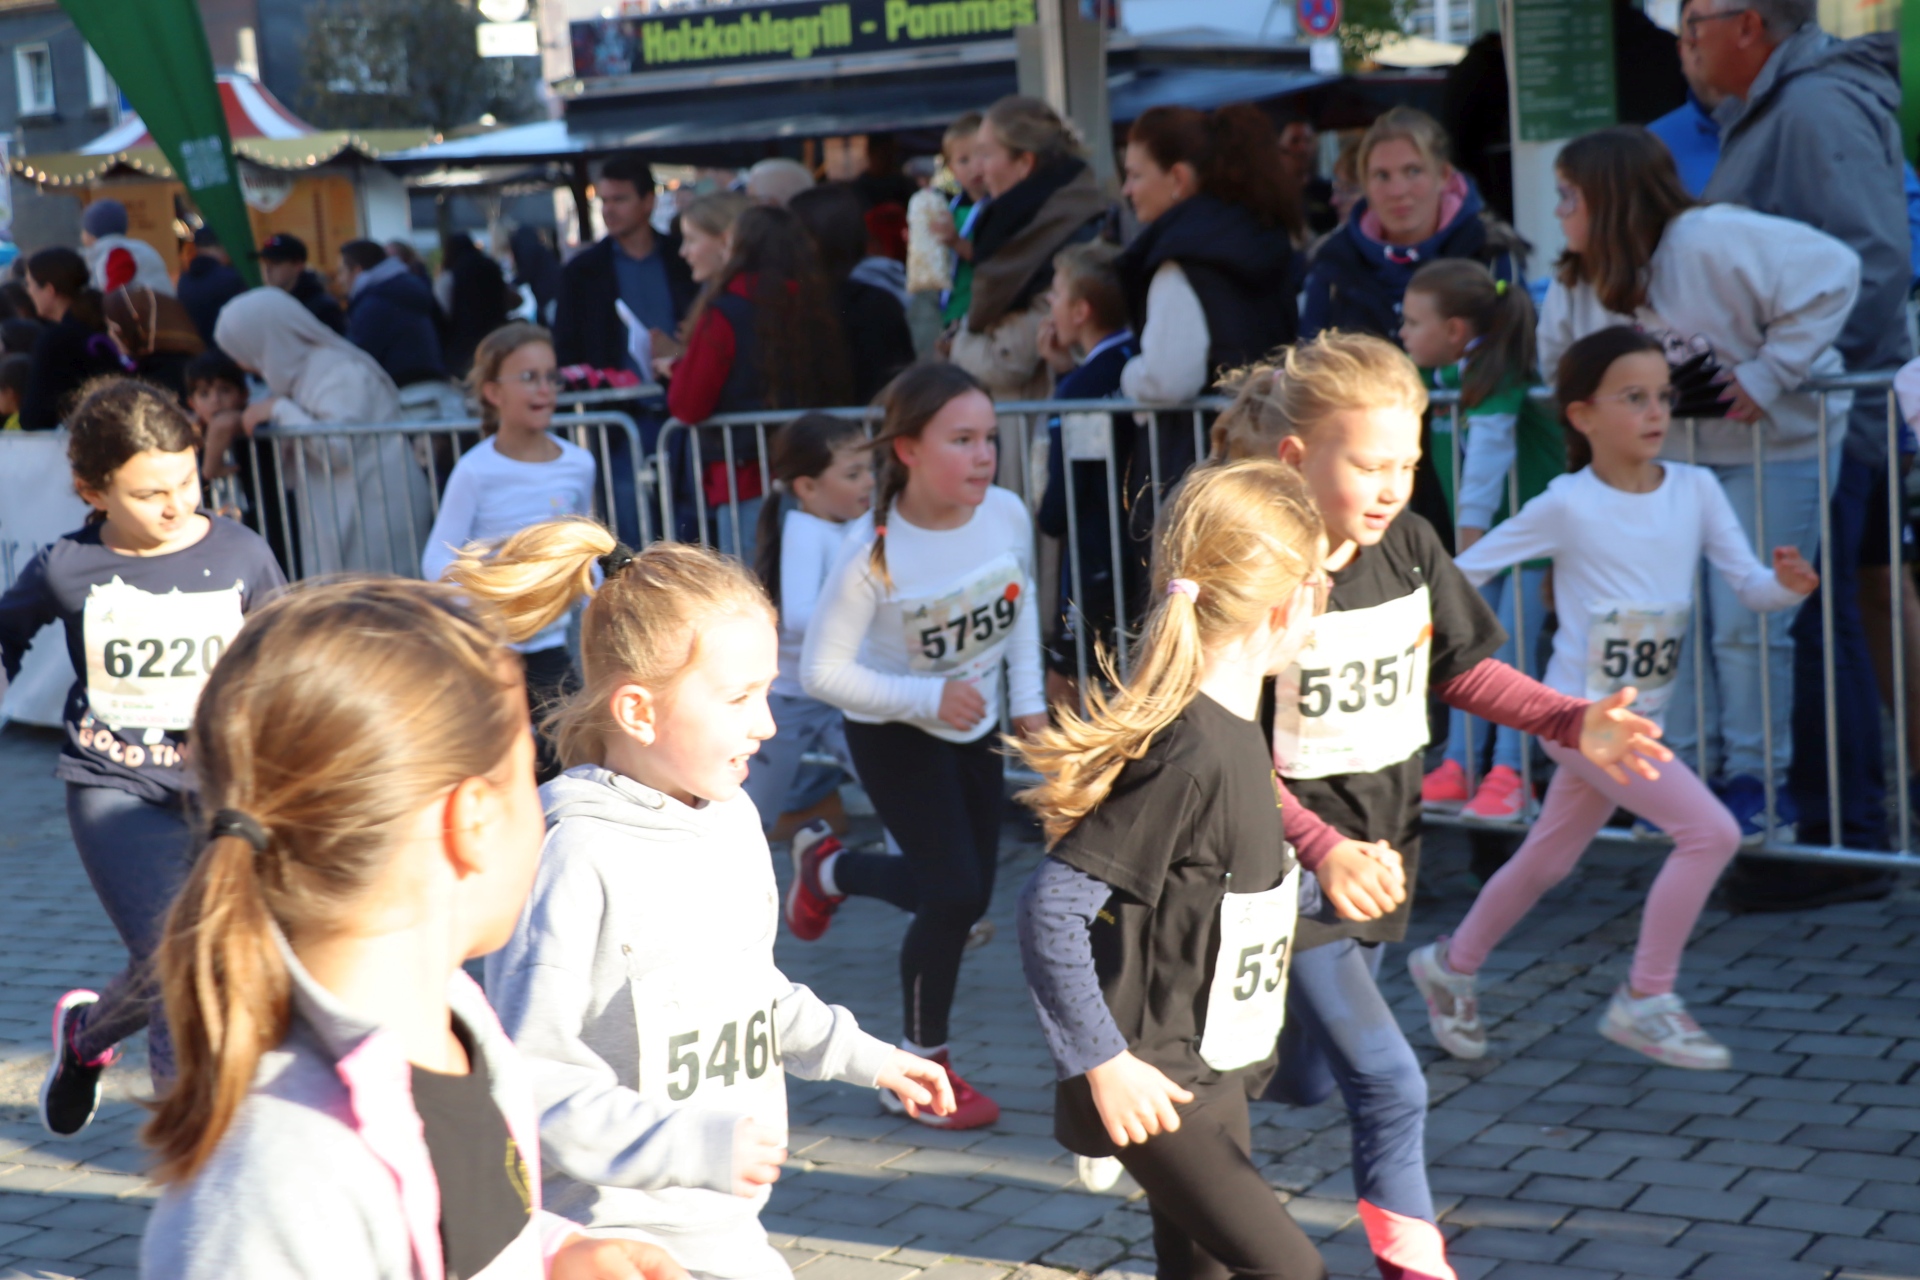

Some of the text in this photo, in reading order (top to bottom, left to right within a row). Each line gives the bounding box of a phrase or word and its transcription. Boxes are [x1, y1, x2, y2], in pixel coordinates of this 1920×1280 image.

[643, 0, 1037, 64] Holzkohlegrill - Pommes
[103, 635, 226, 679] 6220
[920, 595, 1015, 659] 5759
[1602, 634, 1684, 678] 583
[1233, 935, 1288, 1001] 53
